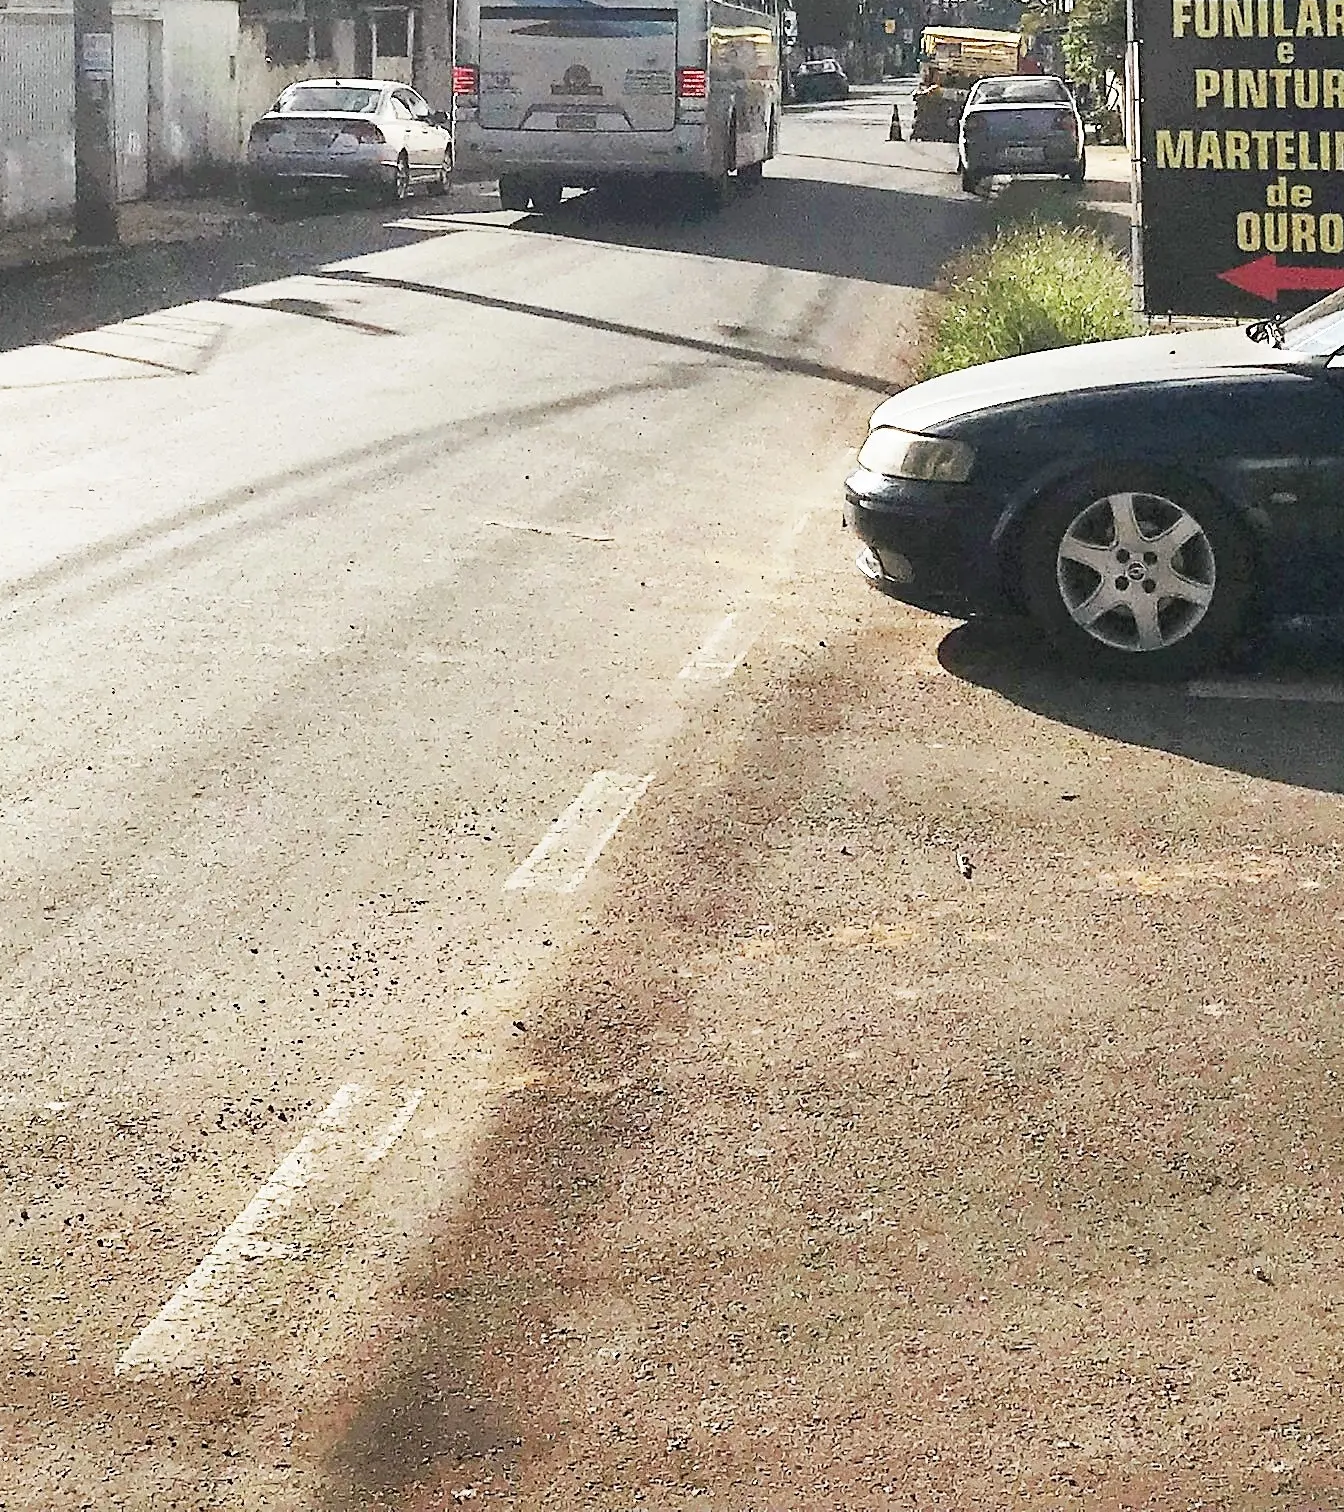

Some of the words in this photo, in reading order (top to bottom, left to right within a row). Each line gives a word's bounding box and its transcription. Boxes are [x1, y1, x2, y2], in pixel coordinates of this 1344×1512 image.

[1276, 40, 1296, 65] e
[1265, 176, 1314, 208] de
[1236, 211, 1344, 254] OURO
